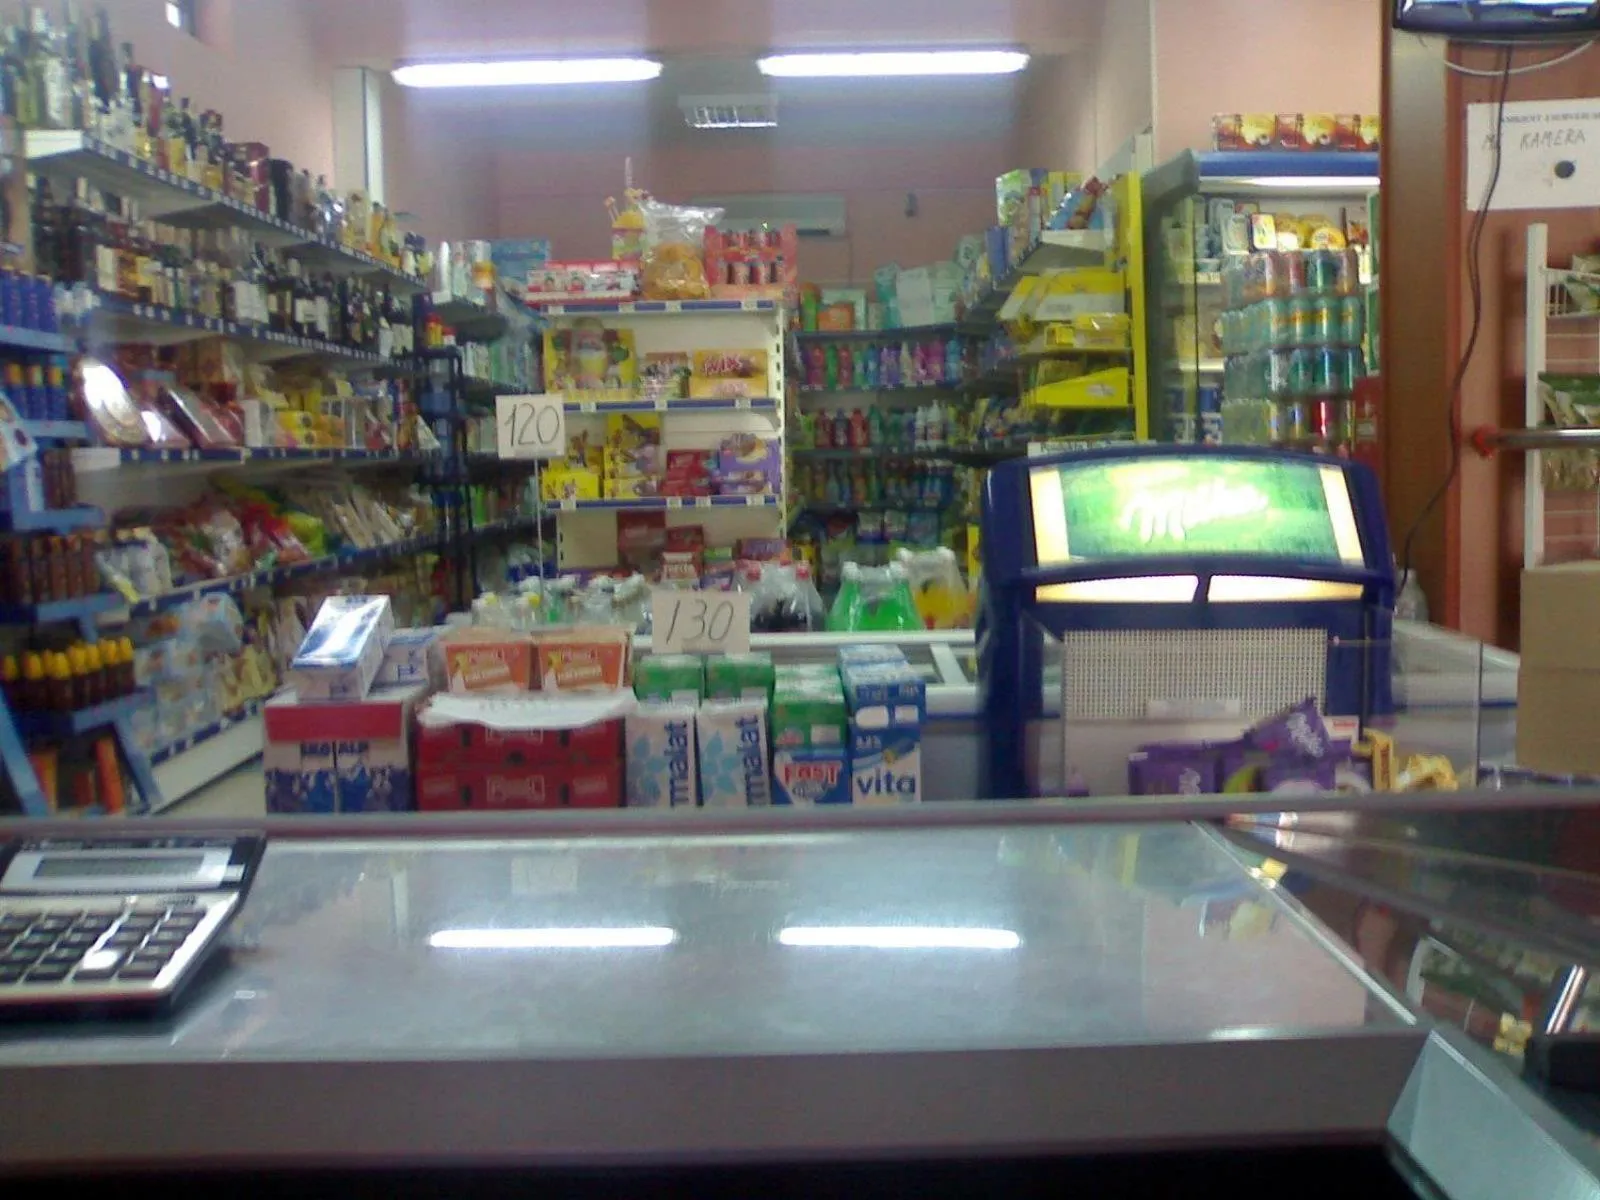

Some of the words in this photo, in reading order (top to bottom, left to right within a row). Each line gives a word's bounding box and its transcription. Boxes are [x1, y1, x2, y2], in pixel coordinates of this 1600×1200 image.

[1521, 129, 1586, 152] KAMERA
[504, 402, 559, 447] 120
[666, 599, 733, 643] 130
[856, 771, 914, 798] vita
